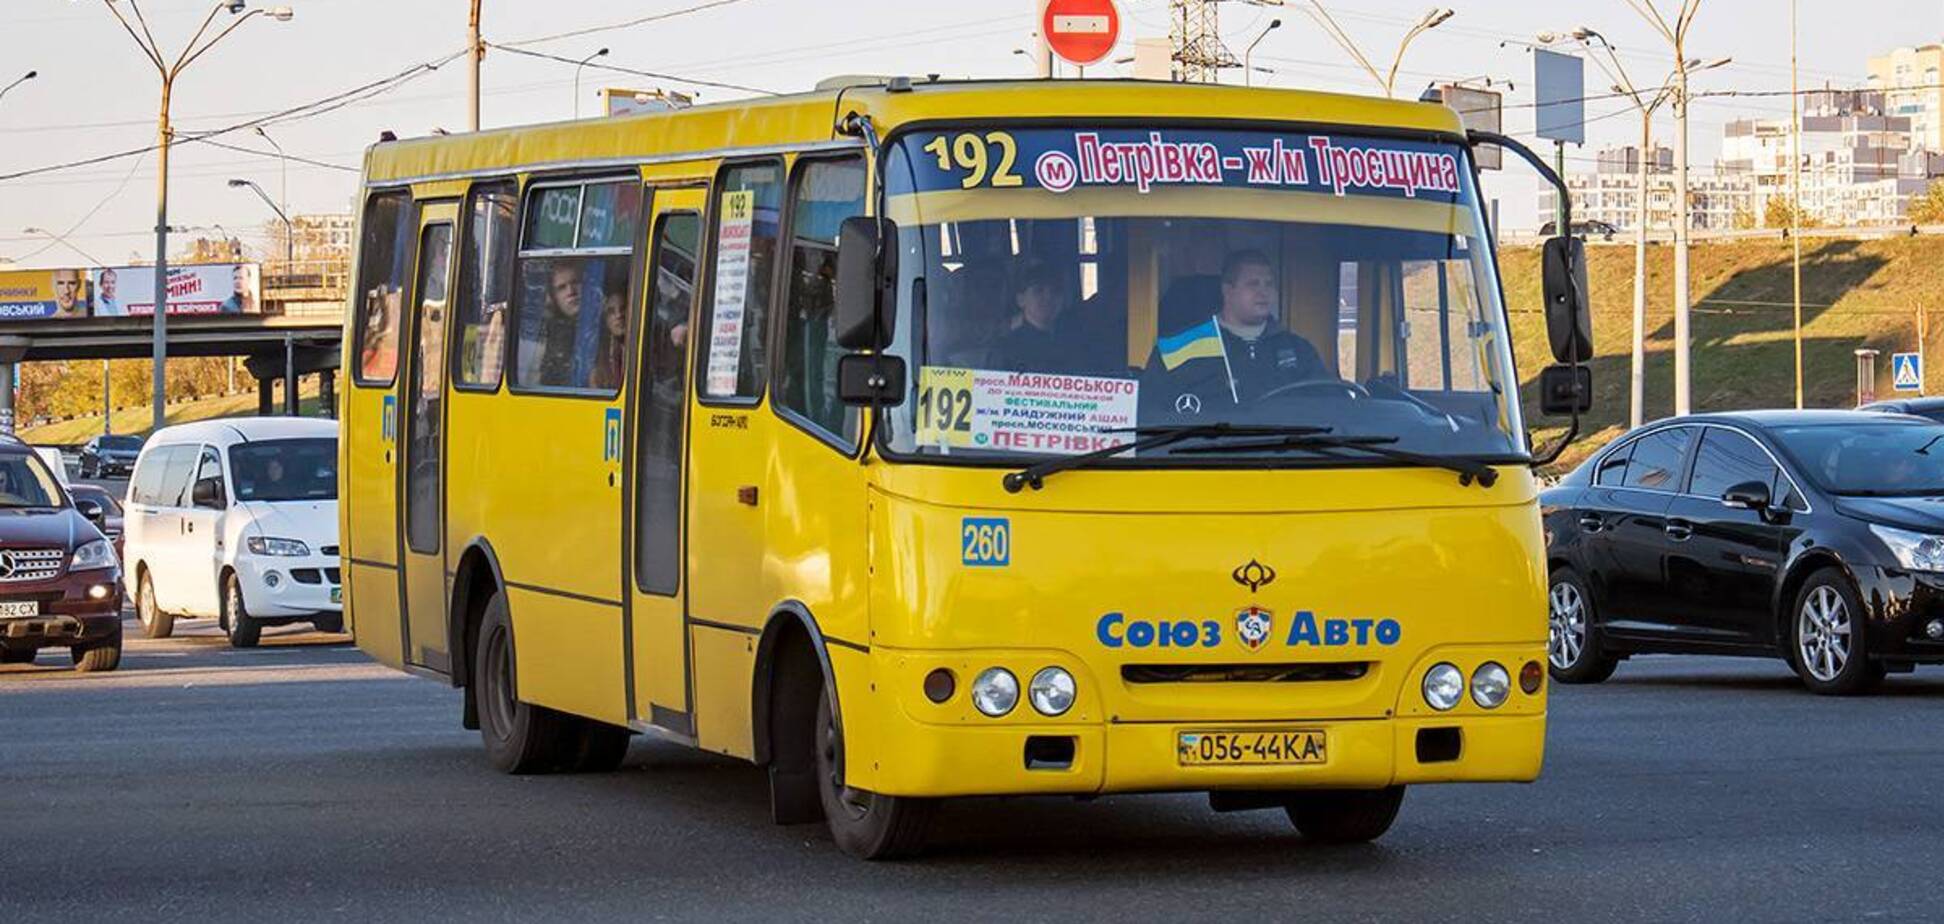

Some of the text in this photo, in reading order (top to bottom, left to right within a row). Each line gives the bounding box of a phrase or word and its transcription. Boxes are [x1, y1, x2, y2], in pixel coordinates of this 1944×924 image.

[924, 131, 1023, 189] 192
[1075, 132, 1223, 193] Петрівка
[1243, 138, 1309, 185] ж/м
[1308, 135, 1461, 198] Троєщина
[920, 386, 972, 432] 192
[1003, 408, 1086, 421] РАЙДУЖНИЙ
[1089, 414, 1128, 424] АШАН
[992, 431, 1123, 452] ПЕТРІВКА
[964, 525, 1007, 561] 260
[1097, 613, 1221, 647] Союз
[1286, 611, 1401, 646] Авто
[1200, 735, 1319, 760] 056-44КА
